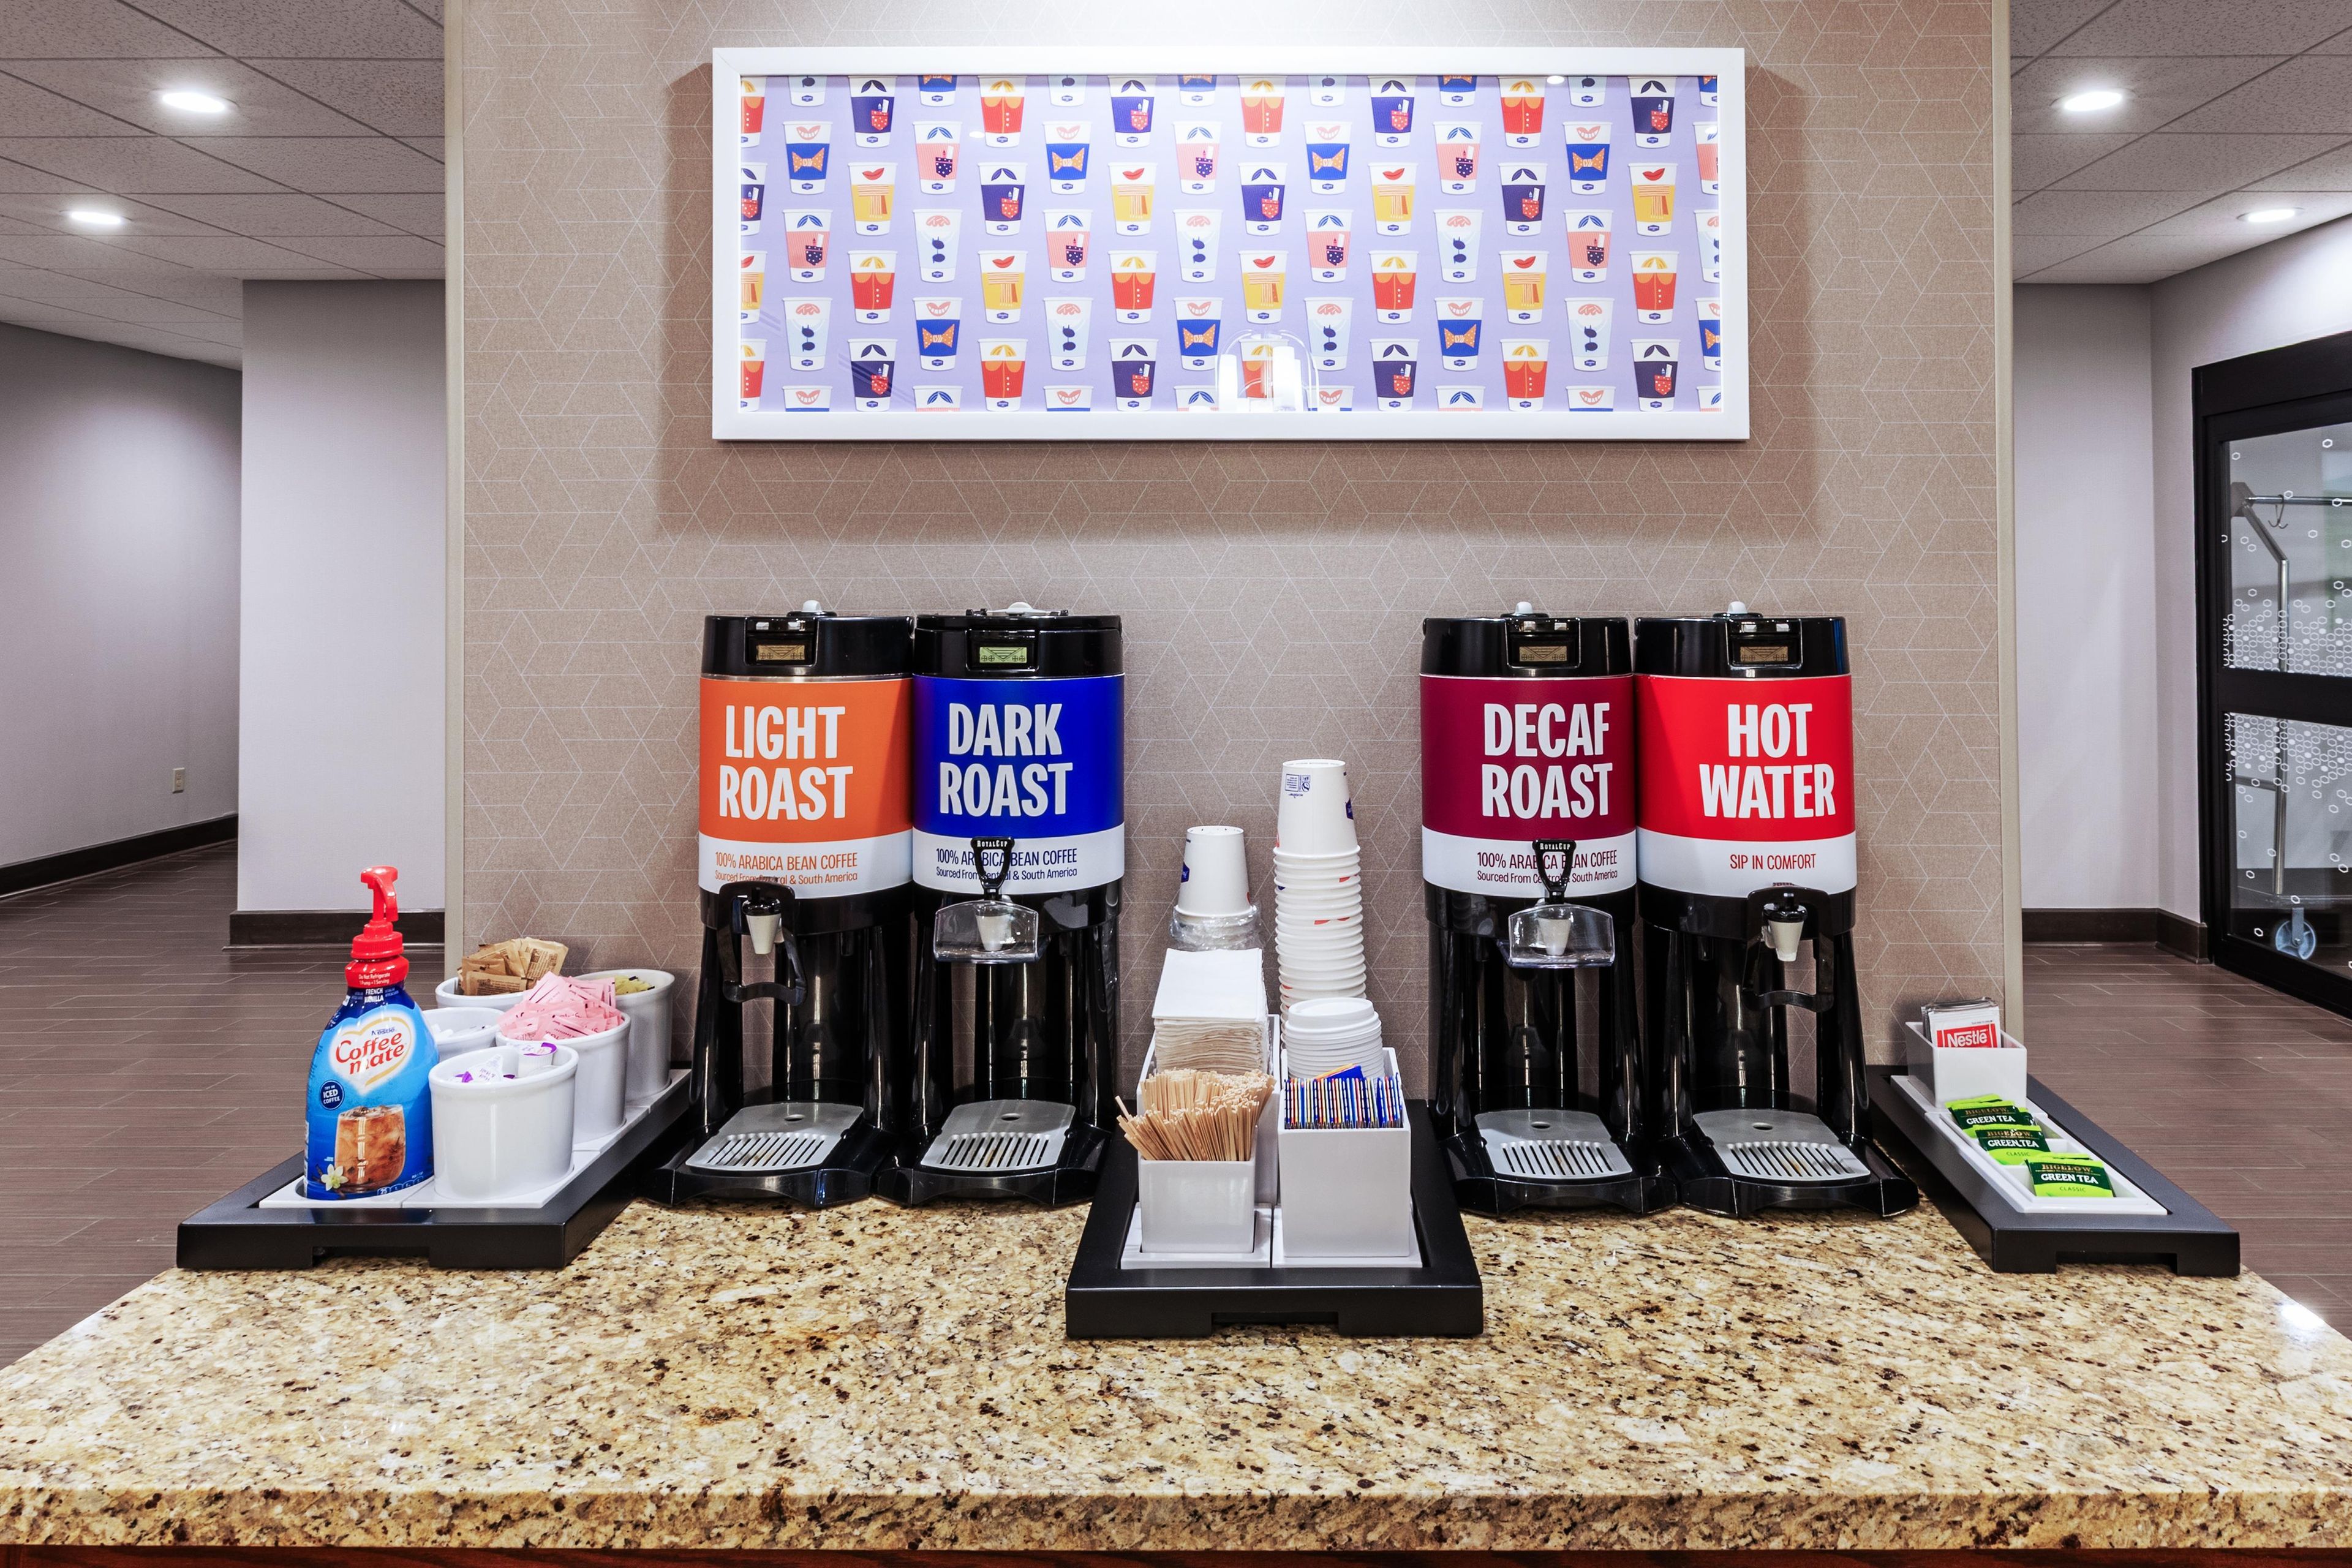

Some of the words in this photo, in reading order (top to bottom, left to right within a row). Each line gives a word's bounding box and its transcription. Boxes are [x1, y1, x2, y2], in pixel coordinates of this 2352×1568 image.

[725, 704, 845, 760] LIGHT
[949, 703, 1062, 756] DARK
[1484, 703, 1610, 758] DECAF
[1727, 703, 1812, 758] HOT
[719, 765, 853, 821] ROAST
[940, 761, 1072, 817] ROAST
[1482, 763, 1613, 820] ROAST
[1698, 763, 1836, 820] WATER
[715, 851, 736, 869] 100%
[739, 854, 783, 870] ARABICA
[787, 856, 816, 870] BEAN
[821, 852, 858, 870] COFFEE
[936, 848, 959, 864] 100%
[961, 851, 1005, 867] ARBICA
[1011, 851, 1039, 867] BEAN
[1043, 848, 1077, 865] COFFEE
[1477, 851, 1506, 869] 100%
[1591, 850, 1617, 867] COFFEE
[1730, 854, 1748, 869] SIP
[1752, 855, 1763, 870] IN
[1767, 853, 1816, 870] COMFORT
[715, 870, 738, 882] Sourced
[790, 875, 797, 885] &
[798, 874, 823, 884] South
[825, 871, 858, 883] America
[936, 867, 960, 879] Sourced
[1012, 870, 1020, 880] &
[1022, 869, 1045, 880] South
[1047, 867, 1077, 879] America
[1477, 870, 1509, 883] Sourced
[1510, 873, 1531, 883] From
[1572, 871, 1593, 883] South
[1594, 869, 1618, 881] America
[336, 1033, 402, 1063] Coffee
[323, 1088, 338, 1098] ICED
[323, 1096, 341, 1104] COFFEE
[1966, 1115, 1996, 1125] GREEN
[2019, 1139, 2039, 1148] TEA
[2041, 1164, 2093, 1173] BIGELOW
[2040, 1173, 2076, 1182] GREEN
[2076, 1174, 2099, 1185] TEA
